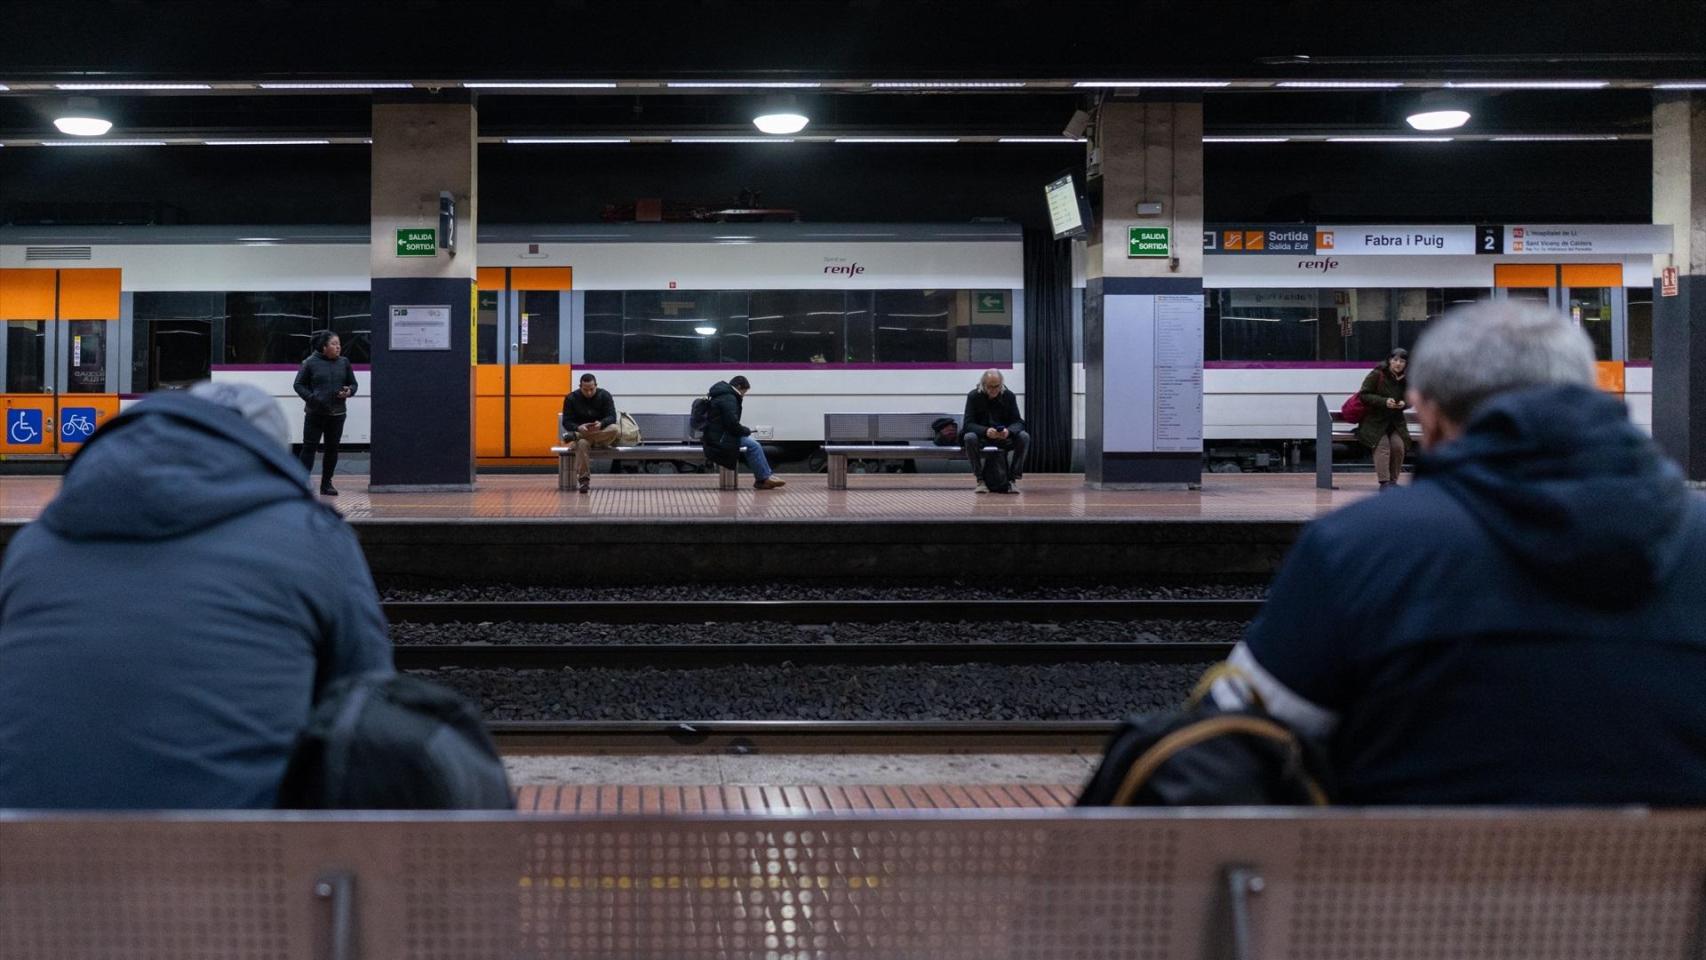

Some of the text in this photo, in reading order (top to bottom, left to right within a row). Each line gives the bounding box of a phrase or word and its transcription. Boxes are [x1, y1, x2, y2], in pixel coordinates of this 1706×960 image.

[408, 233, 433, 241] SALIDA
[1141, 232, 1166, 240] SALIDA
[1268, 231, 1309, 241] Sortida
[1322, 233, 1334, 246] R
[1138, 242, 1169, 250] SORTIDA
[1268, 242, 1309, 250] Salida Exit
[1365, 234, 1444, 249] Fabra i Puig
[1484, 235, 1496, 251] 2
[406, 243, 436, 251] SORTIDA
[1298, 256, 1339, 274] renfe
[824, 262, 865, 279] renfe
